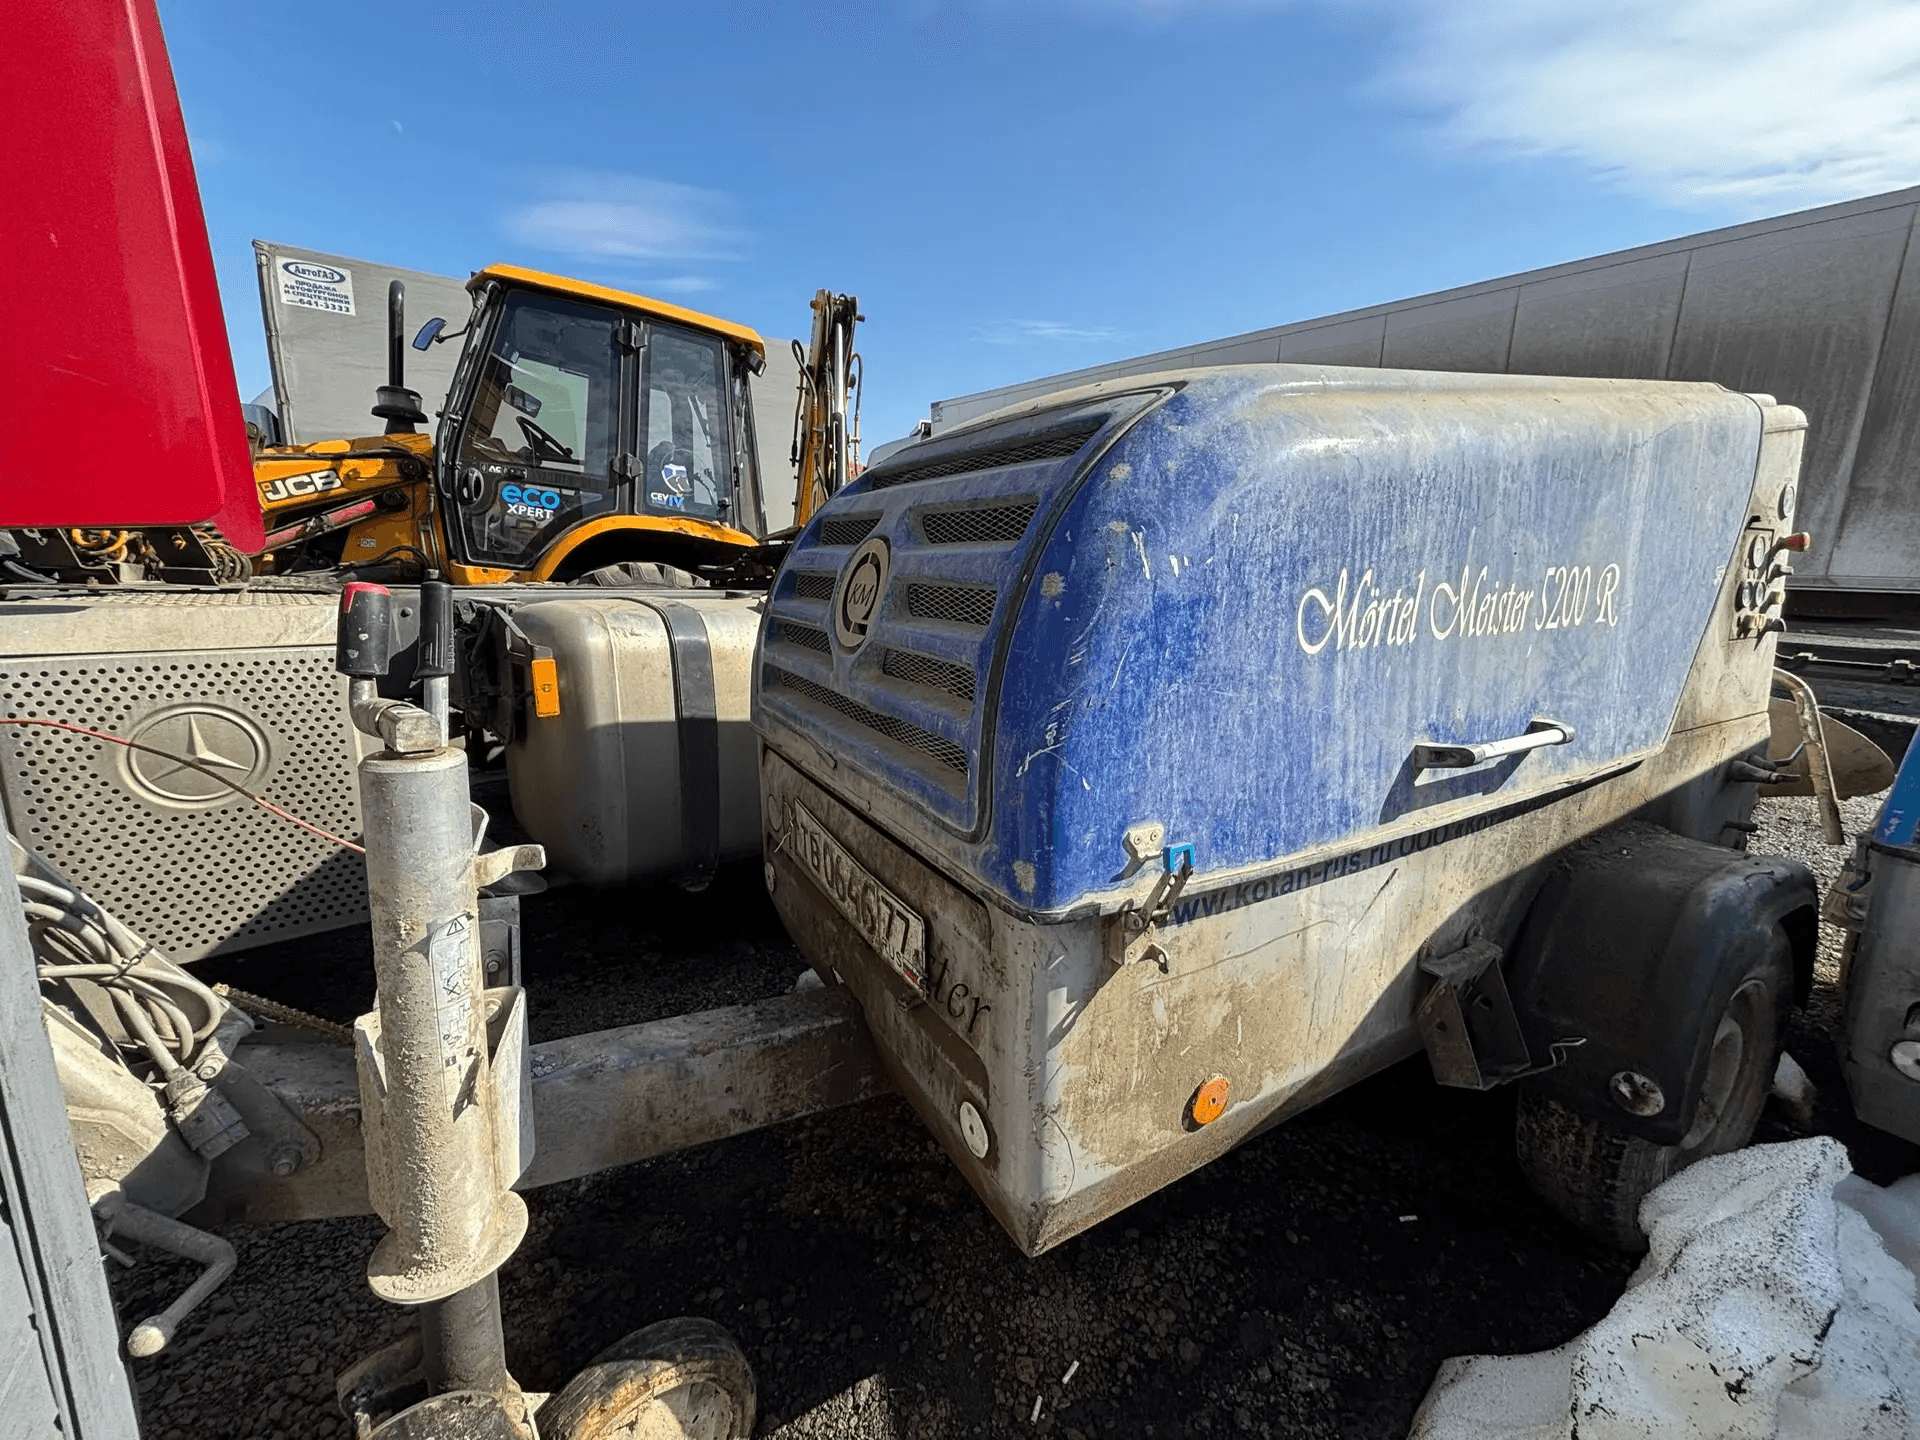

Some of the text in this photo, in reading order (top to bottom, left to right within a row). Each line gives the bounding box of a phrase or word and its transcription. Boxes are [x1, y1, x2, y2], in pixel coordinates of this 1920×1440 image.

[295, 266, 334, 280] АвтоГАЗ
[284, 283, 349, 299] АВТОФУРГОНОВ
[295, 280, 337, 292] ПРОДАЖА
[292, 290, 350, 305] СПЕЦТЕХНИКИ
[299, 298, 350, 312] 641-3333
[265, 470, 341, 500] JCB
[501, 485, 560, 509] eco
[506, 503, 554, 519] XPERT
[1297, 563, 1621, 655] Mörtel Meister 5200 R
[1167, 846, 1393, 927] ww.kotan-rus.ru
